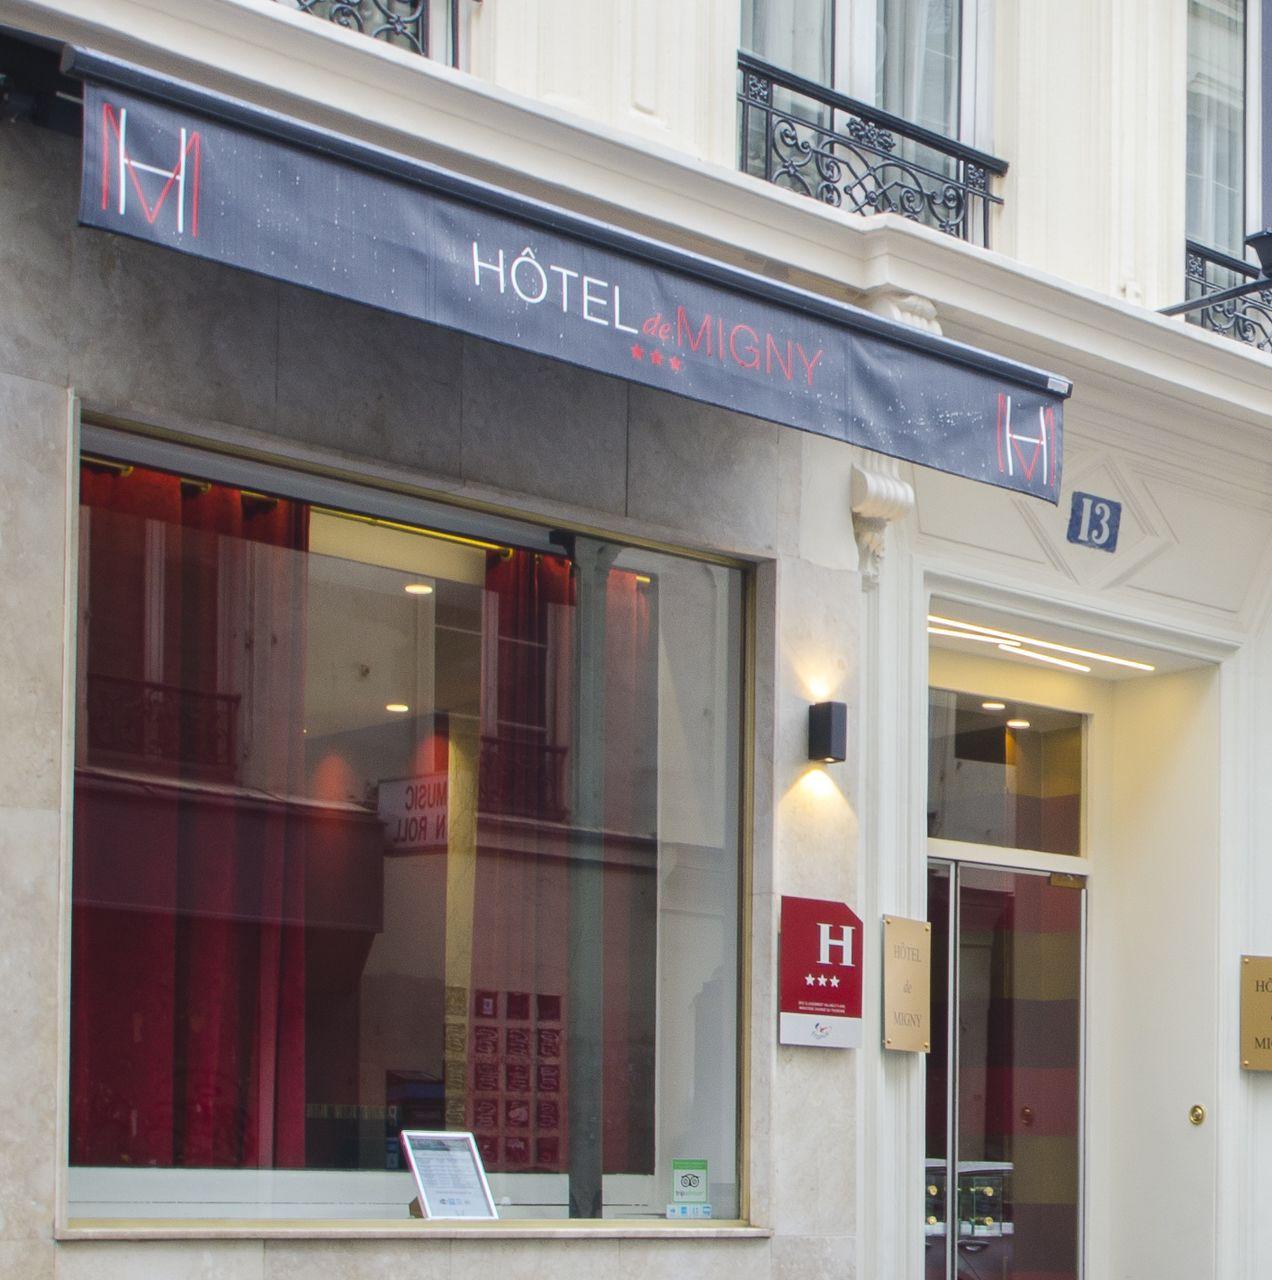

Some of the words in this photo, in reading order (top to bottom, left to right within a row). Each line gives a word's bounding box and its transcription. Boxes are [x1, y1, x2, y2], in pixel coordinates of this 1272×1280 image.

[472, 240, 639, 335] HÔTEL
[642, 312, 673, 341] de
[676, 305, 824, 386] MIGNY
[1077, 497, 1111, 545] 13
[816, 922, 856, 967] H
[893, 941, 922, 963] HÔTEL
[893, 1010, 923, 1028] MIGNY
